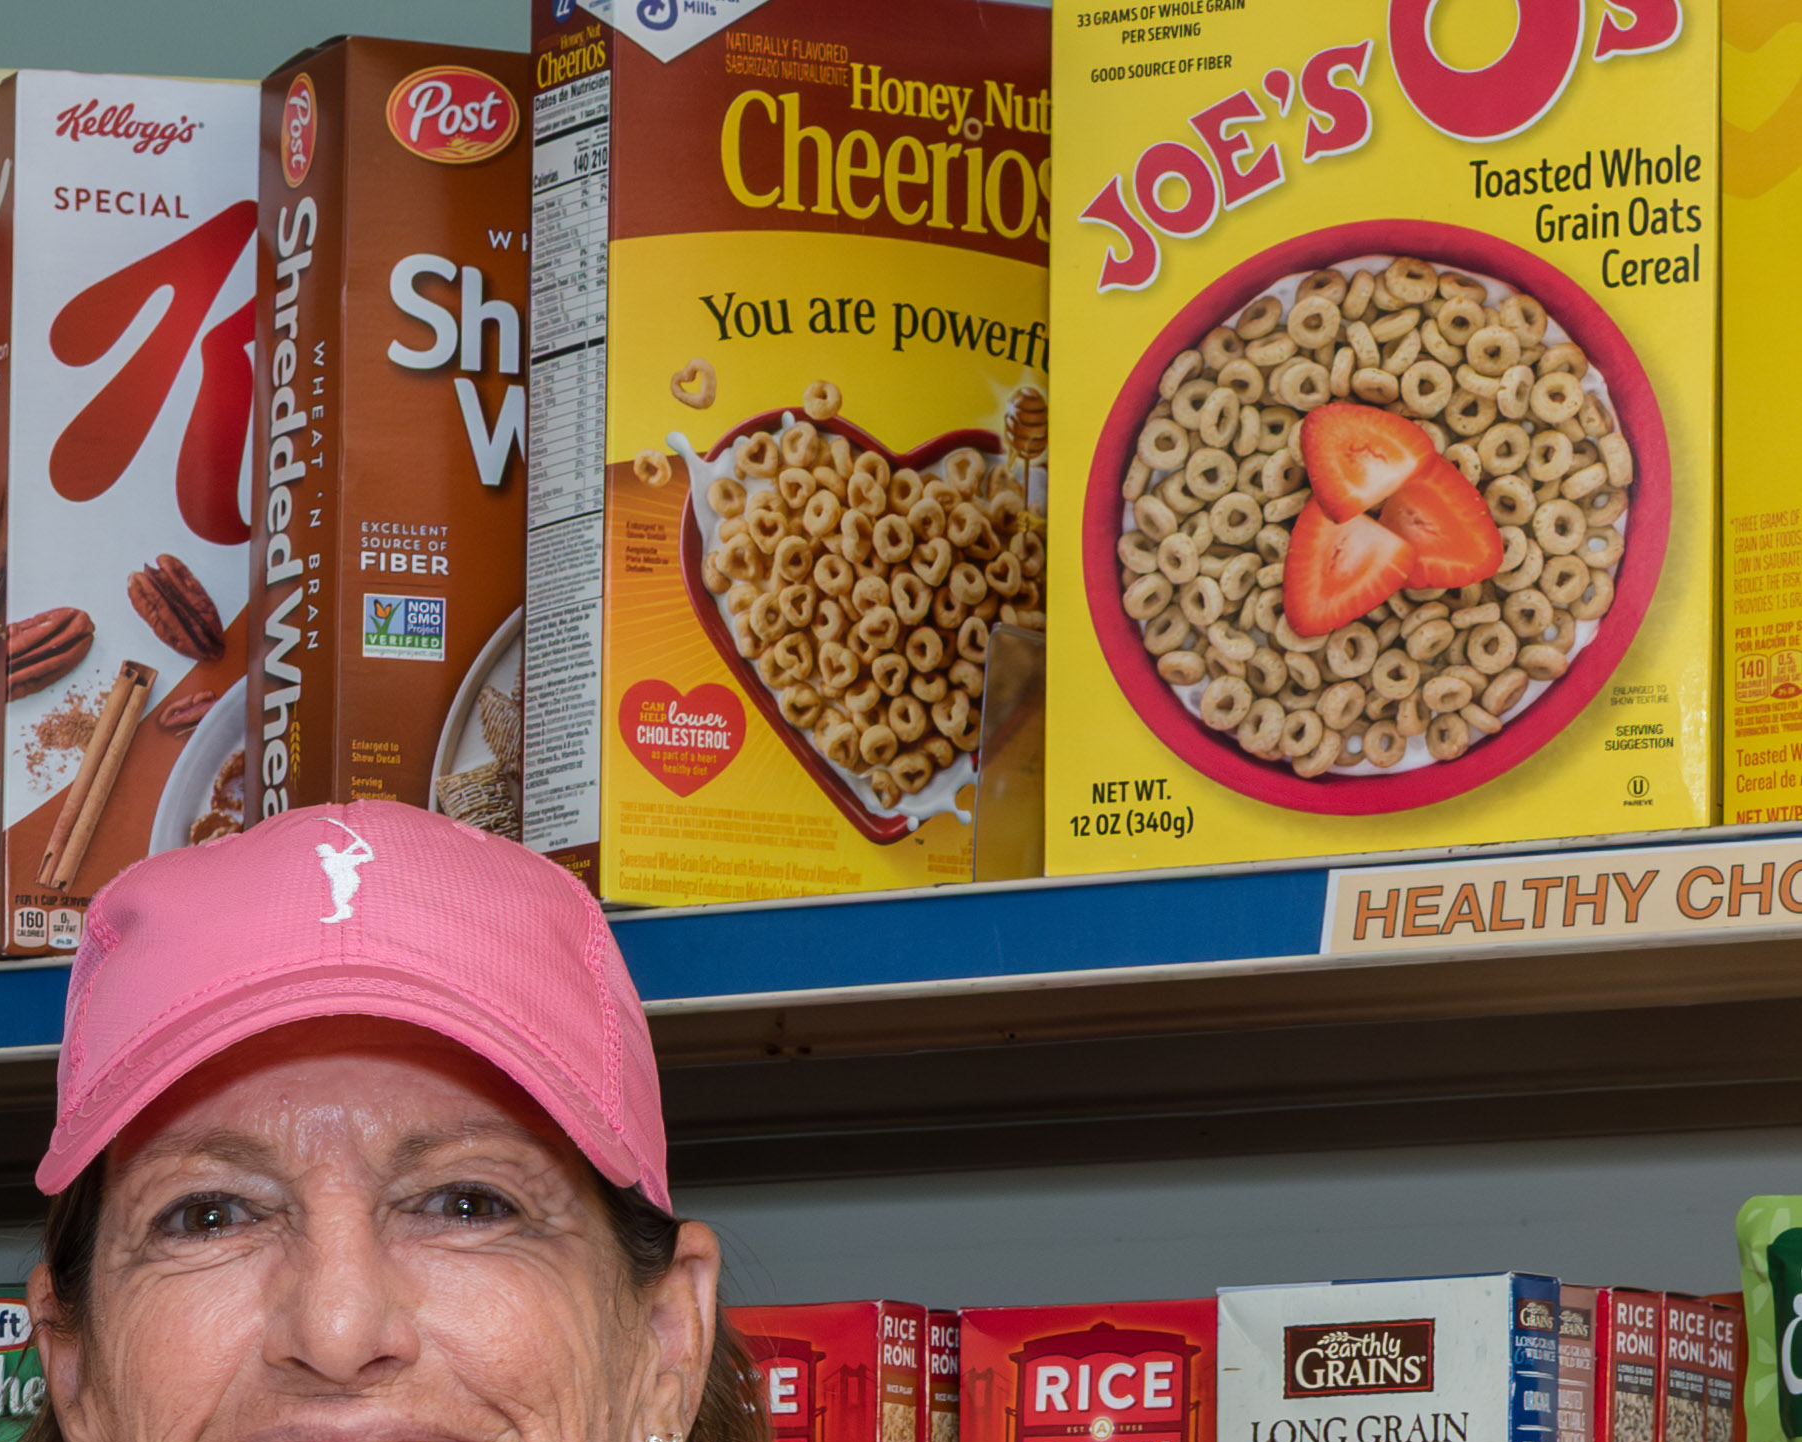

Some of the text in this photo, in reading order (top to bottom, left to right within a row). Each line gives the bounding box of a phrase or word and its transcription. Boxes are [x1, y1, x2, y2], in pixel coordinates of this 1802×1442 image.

[683, 1, 717, 15] Mills
[1077, 1, 1203, 27] 33 GRAMS OF WHOLE
[726, 31, 849, 63] NATURALLY FLAVORED
[1121, 22, 1202, 44] PER SERVING
[1091, 54, 1233, 83] GOOD SOURCE OF FIBER
[408, 80, 503, 143] Post
[850, 62, 973, 136] Honey
[55, 98, 197, 155] Kellogg's
[289, 89, 312, 170] Post
[1469, 144, 1702, 199] Toasted Whole
[54, 186, 190, 220] SPECIAL
[1535, 197, 1702, 243] Grain Oats
[1601, 243, 1700, 288] Cereal
[699, 292, 876, 341] You are
[265, 196, 318, 584] Shredded
[306, 341, 325, 650] WHEAT BRAN
[361, 521, 449, 538] EXCELLENT
[361, 536, 448, 552] SOURCE OF
[359, 550, 450, 575] FIBER
[407, 613, 441, 626] GMO
[408, 600, 441, 614] NON
[367, 633, 440, 649] VERIFIED
[407, 623, 440, 635] Project
[667, 700, 728, 729] lower
[1604, 737, 1674, 751] SUGGESTION
[1615, 724, 1664, 737] SERVING
[1735, 744, 1788, 768] Toasted
[1092, 779, 1172, 804] NET WT.
[1735, 772, 1778, 793] Cereal
[1070, 809, 1194, 839] 12 OZ (340g)
[1352, 869, 1659, 941] HEALTHY
[17, 911, 45, 929] 160
[883, 1315, 918, 1341] RICE
[1616, 1302, 1655, 1330] RICE
[1668, 1308, 1705, 1337] RICE
[1324, 1331, 1402, 1359] earthly
[1295, 1348, 1423, 1390] GRAINS
[1034, 1360, 1174, 1412] RICE
